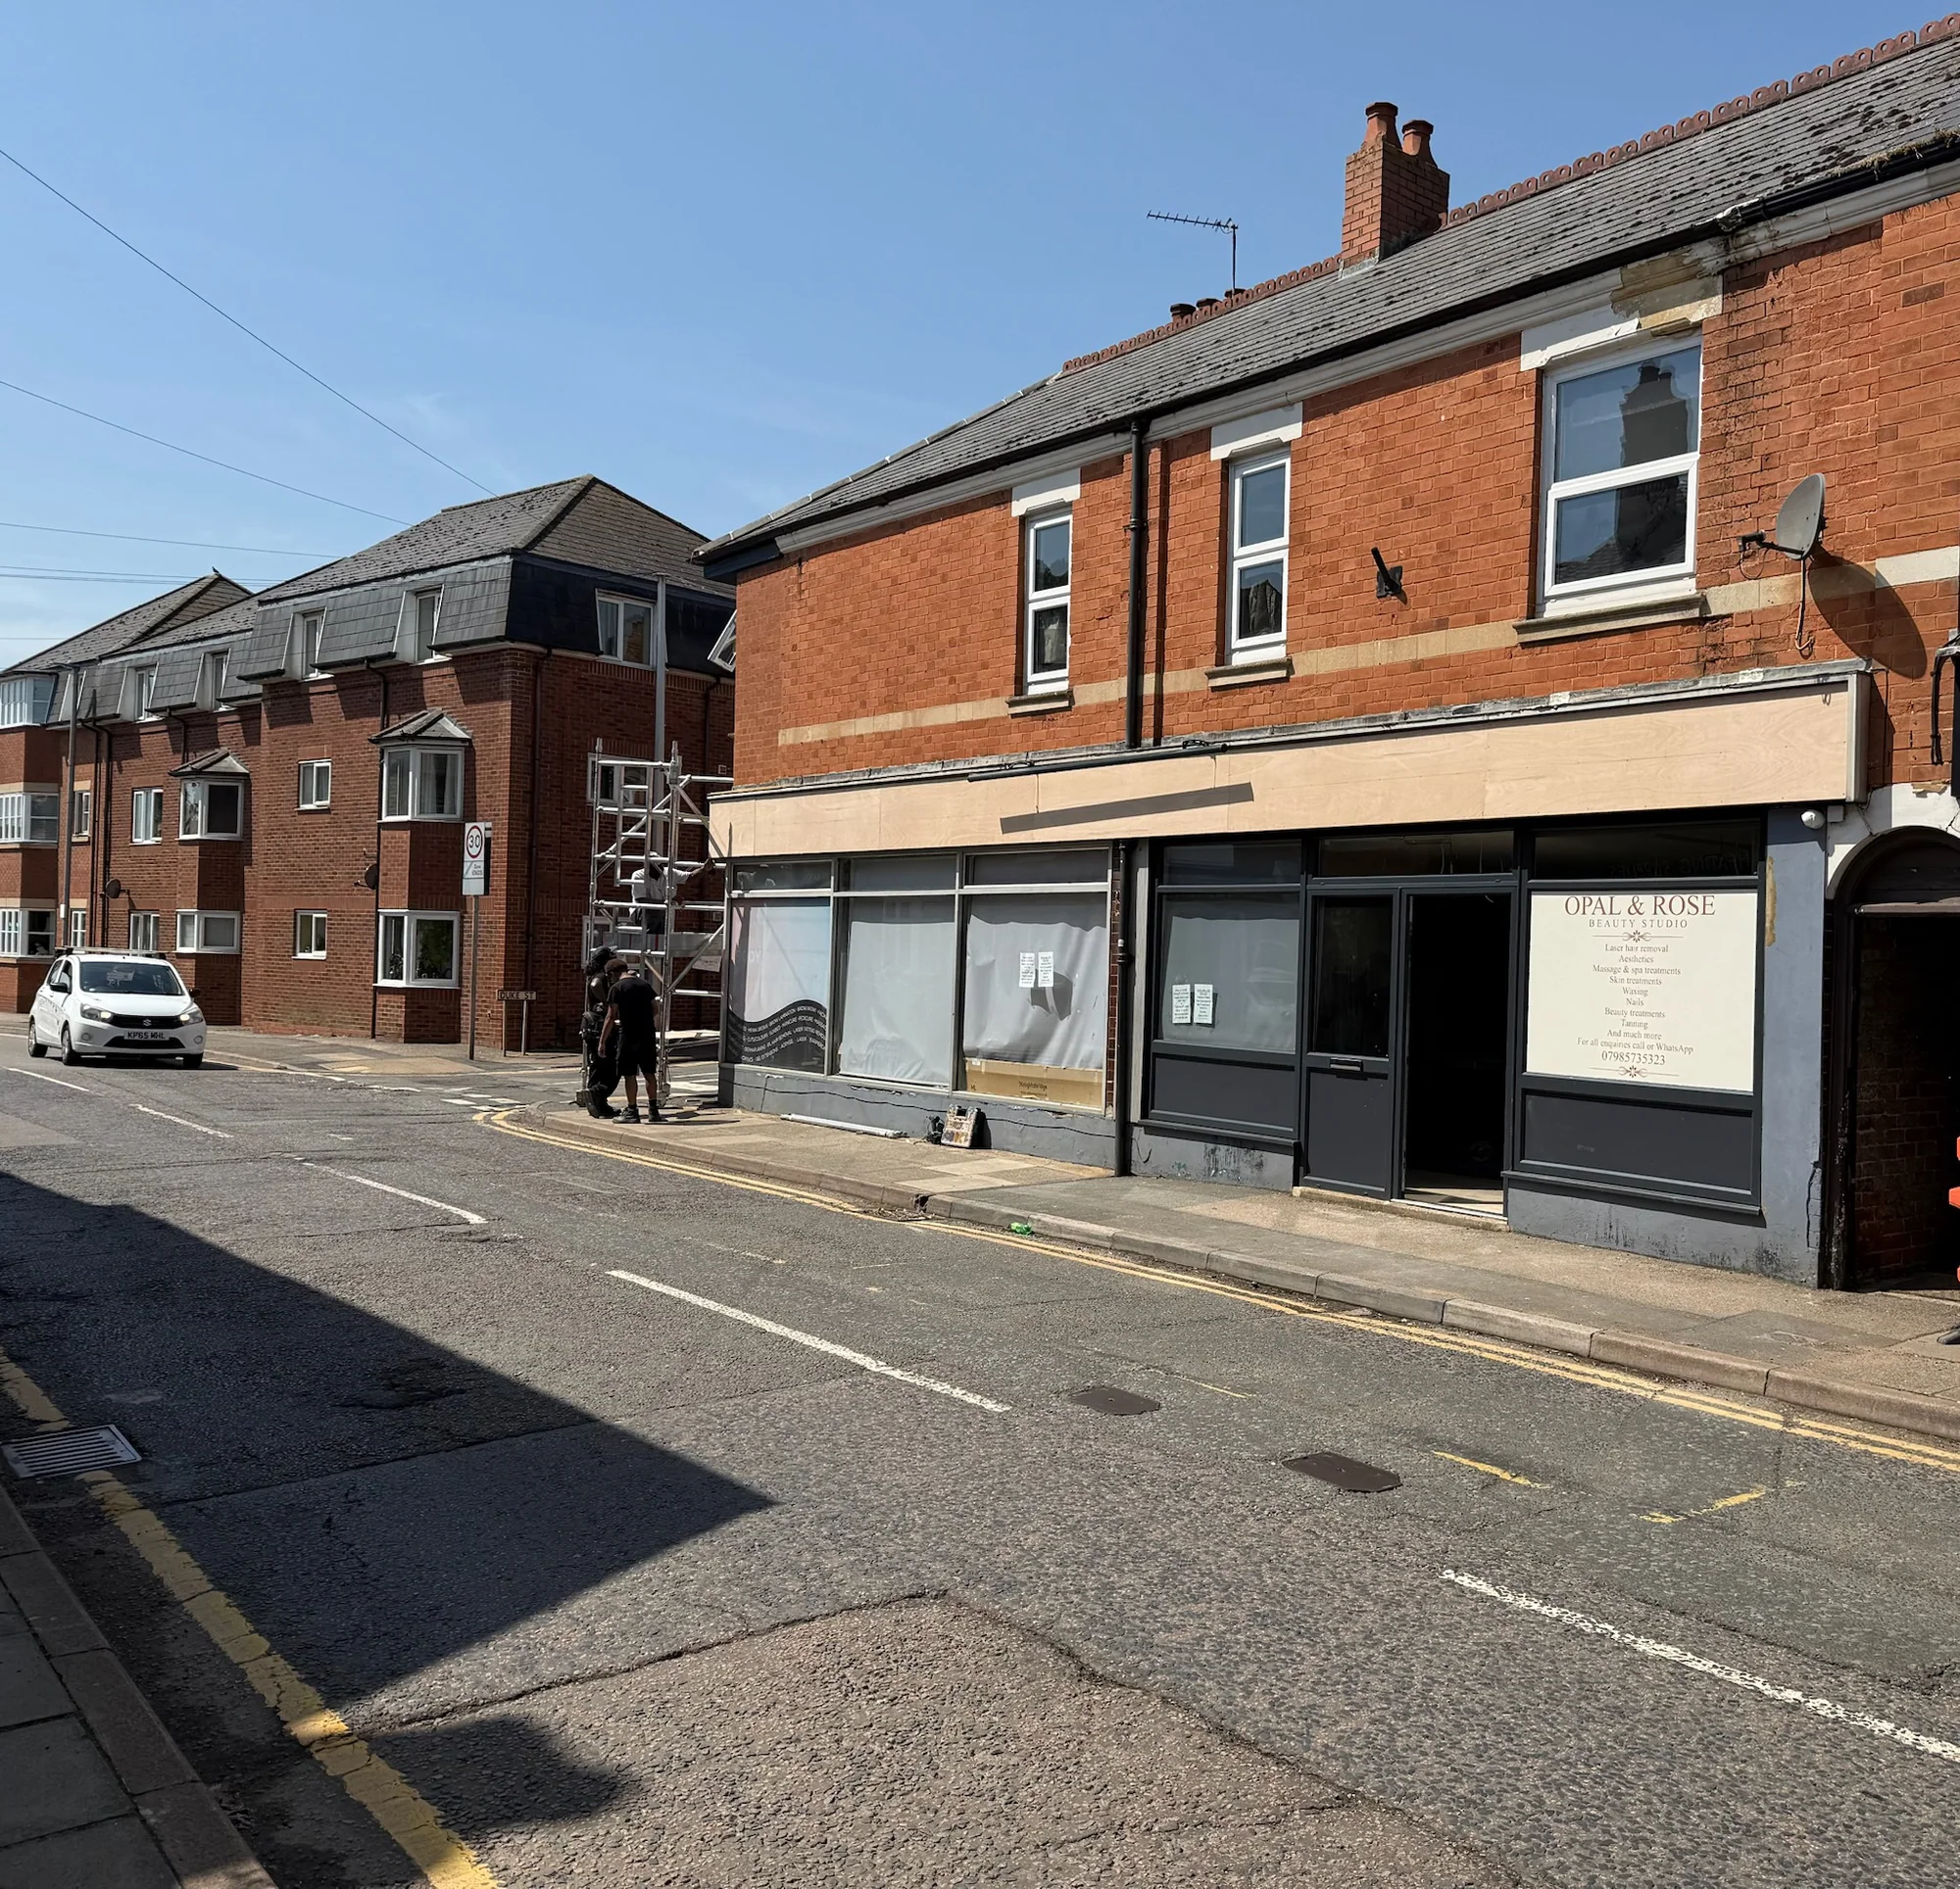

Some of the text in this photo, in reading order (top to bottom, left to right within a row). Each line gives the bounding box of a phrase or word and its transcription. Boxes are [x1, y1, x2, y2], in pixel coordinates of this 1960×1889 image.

[468, 835, 481, 848] 30
[1565, 895, 1716, 916] OPAL & ROSE
[1589, 919, 1688, 928] BEAUTY STUDIO
[1604, 944, 1669, 953] Laser hair removal
[1618, 954, 1654, 963] Aesthetics
[1592, 964, 1622, 975] Massage
[1623, 965, 1630, 974] &
[1631, 967, 1643, 976] spa
[1609, 975, 1662, 986] Skin treatments
[1622, 987, 1648, 997] Waxing
[1626, 997, 1644, 1006] Nails
[1604, 1007, 1665, 1018] Beauty treatments
[1620, 1019, 1648, 1030] Tanning
[1606, 1029, 1622, 1038] And
[1577, 1037, 1589, 1045] For
[1600, 1040, 1631, 1049] enquiries
[1632, 1041, 1645, 1050] call
[1655, 1042, 1693, 1055] WhatsApp
[1601, 1050, 1666, 1066] 07985735323
